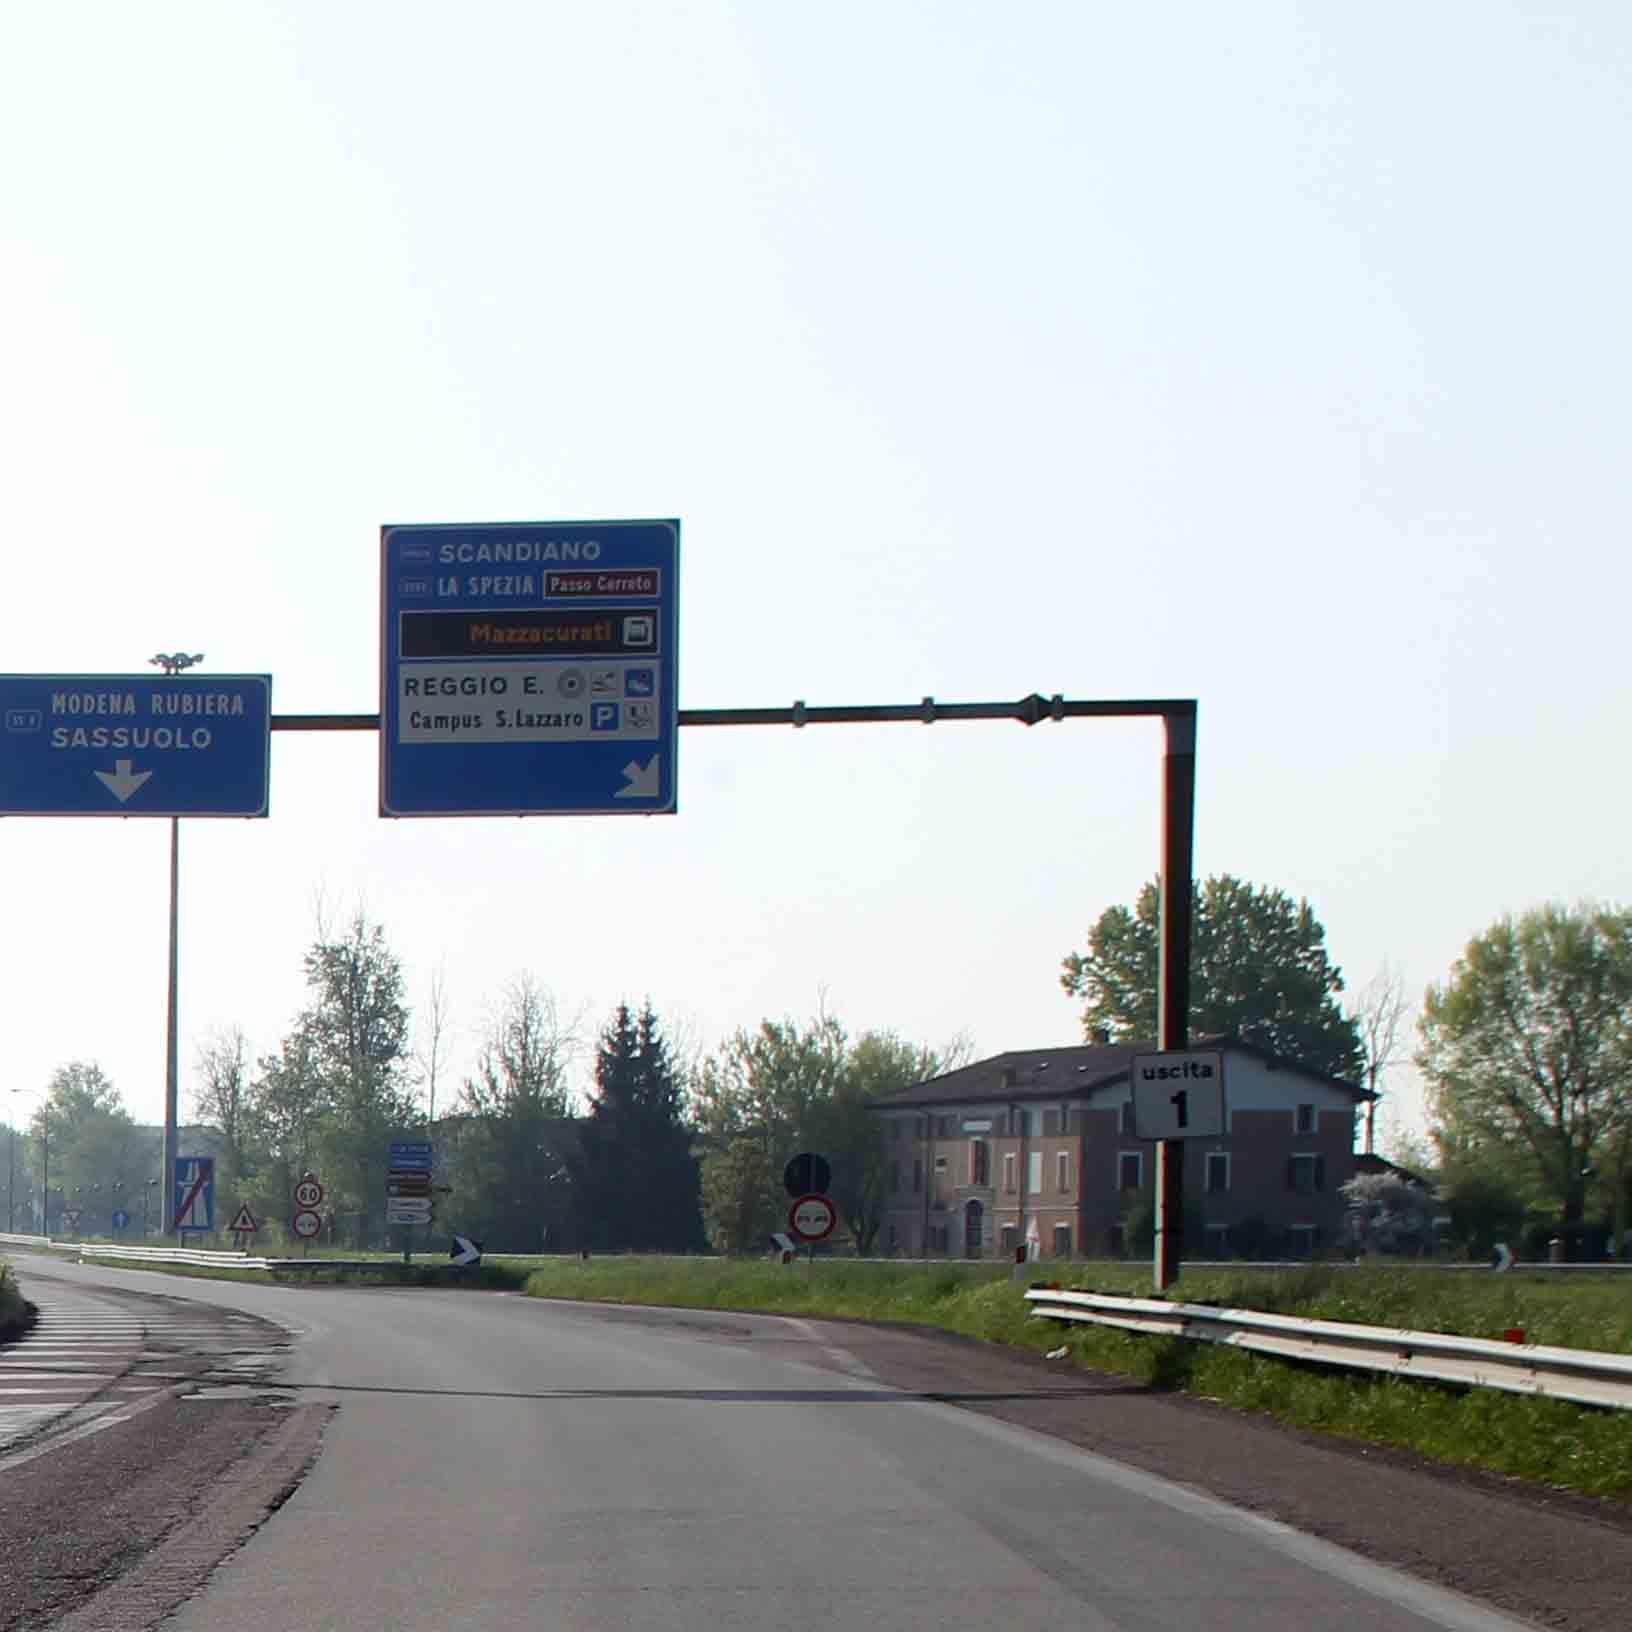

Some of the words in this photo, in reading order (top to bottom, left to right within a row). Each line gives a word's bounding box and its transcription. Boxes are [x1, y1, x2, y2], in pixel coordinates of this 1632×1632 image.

[439, 541, 601, 564] SCANDIANO
[438, 576, 458, 597] LA
[469, 575, 535, 596] SPEZIA
[550, 576, 592, 592] Passo
[471, 624, 611, 642] Mazzacurati
[404, 677, 508, 697] REGGIO
[523, 676, 544, 695] E.
[51, 694, 136, 715] MODENA
[152, 694, 244, 715] RUBIERA
[410, 711, 482, 733] Campus
[51, 728, 212, 749] SASSUOLO
[1142, 1061, 1213, 1080] uscita
[1170, 1090, 1188, 1128] 1
[300, 1188, 317, 1200] 60
